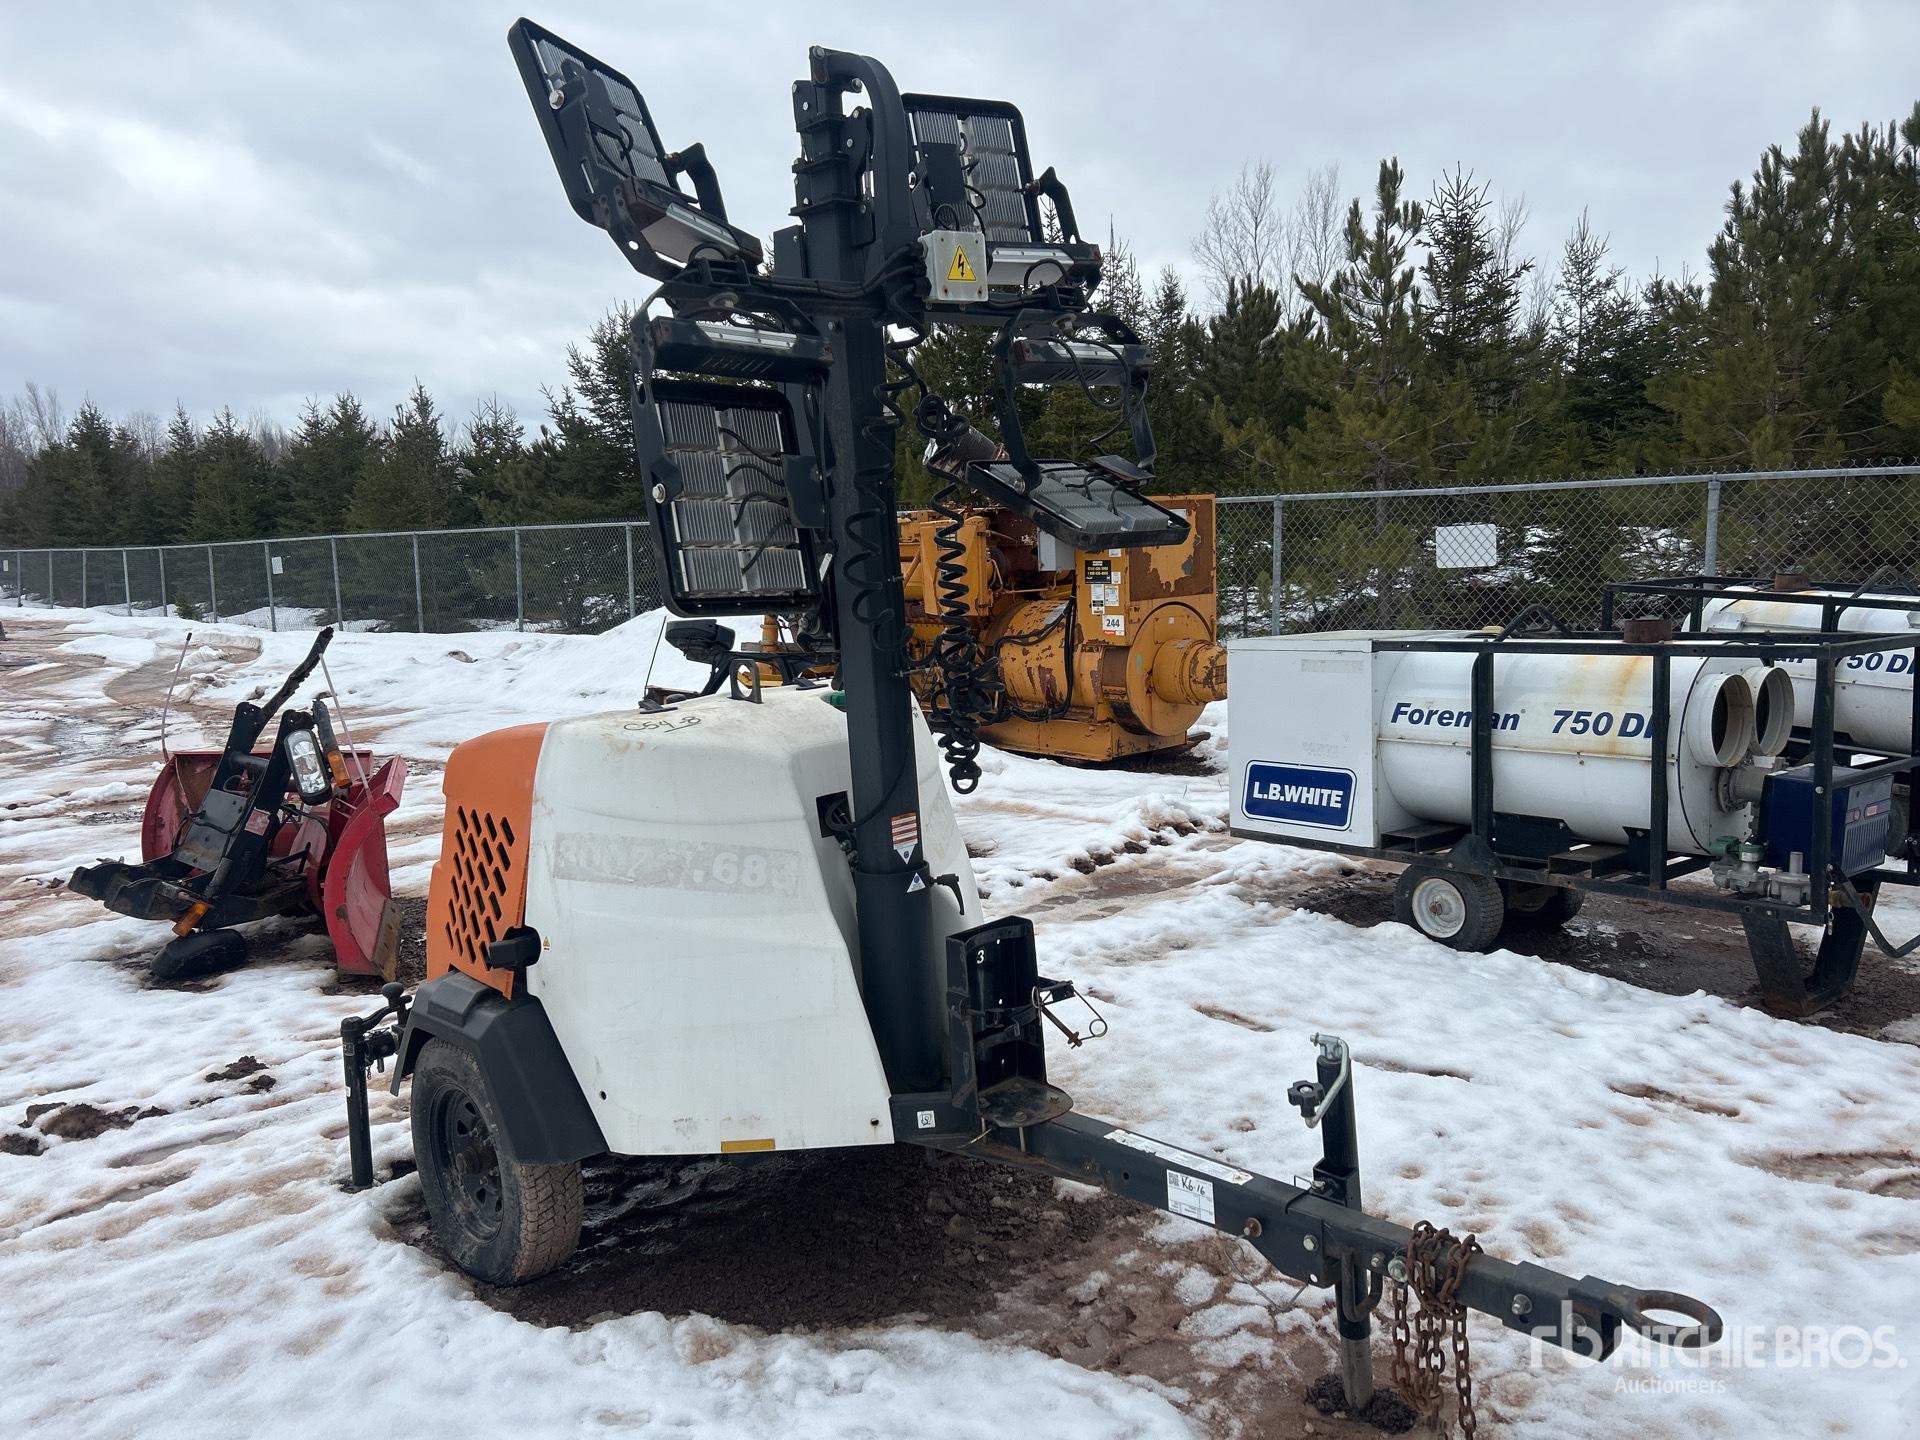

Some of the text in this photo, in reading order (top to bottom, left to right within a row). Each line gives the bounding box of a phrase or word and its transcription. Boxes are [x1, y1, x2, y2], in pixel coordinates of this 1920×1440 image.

[1106, 618, 1120, 628] 244
[1552, 709, 1614, 736] 750
[1252, 781, 1344, 808] L.B.WHITE
